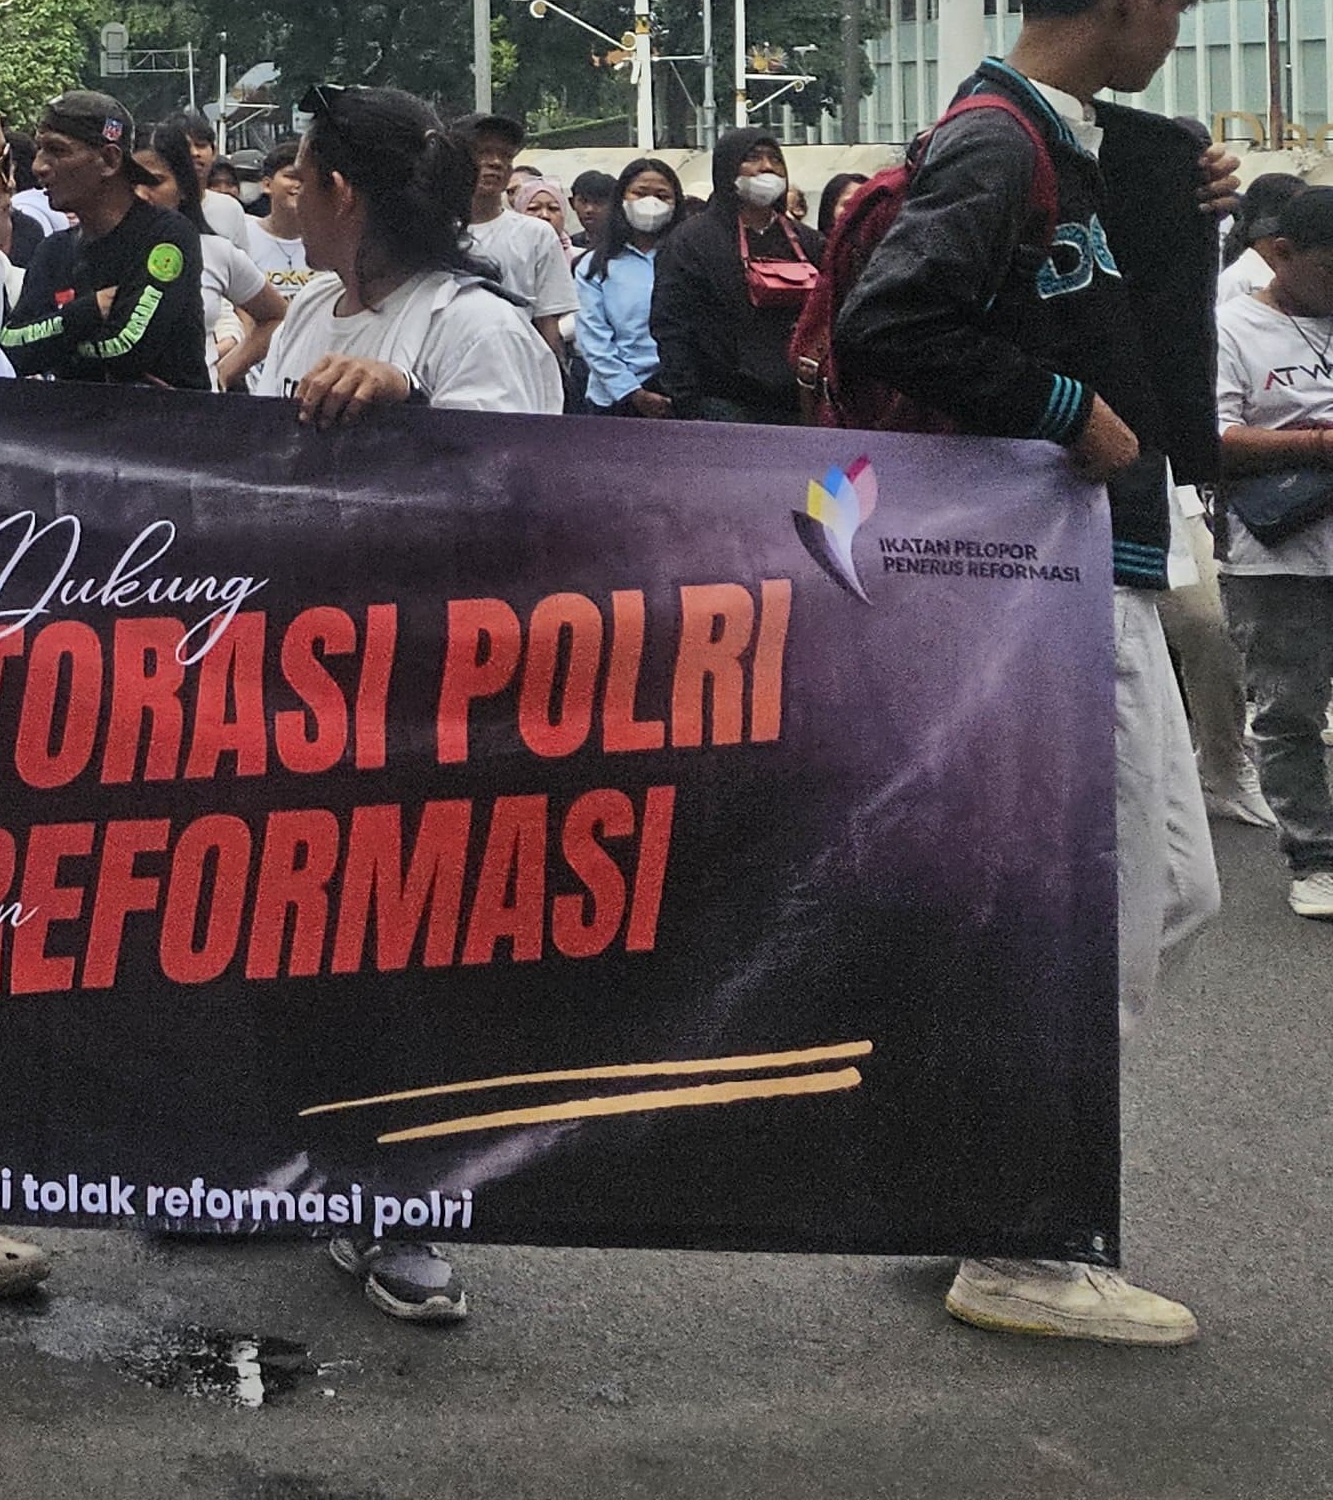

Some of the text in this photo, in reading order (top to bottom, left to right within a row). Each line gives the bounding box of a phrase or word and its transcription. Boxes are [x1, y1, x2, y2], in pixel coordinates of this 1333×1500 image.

[879, 538, 1038, 561] IKATAN PELOPOR
[883, 556, 1081, 583] PENERUS REFORMASI
[437, 578, 793, 764] POLRI
[22, 1173, 135, 1216] tolak
[146, 1177, 362, 1224] reformasi
[375, 1188, 474, 1238] polri
